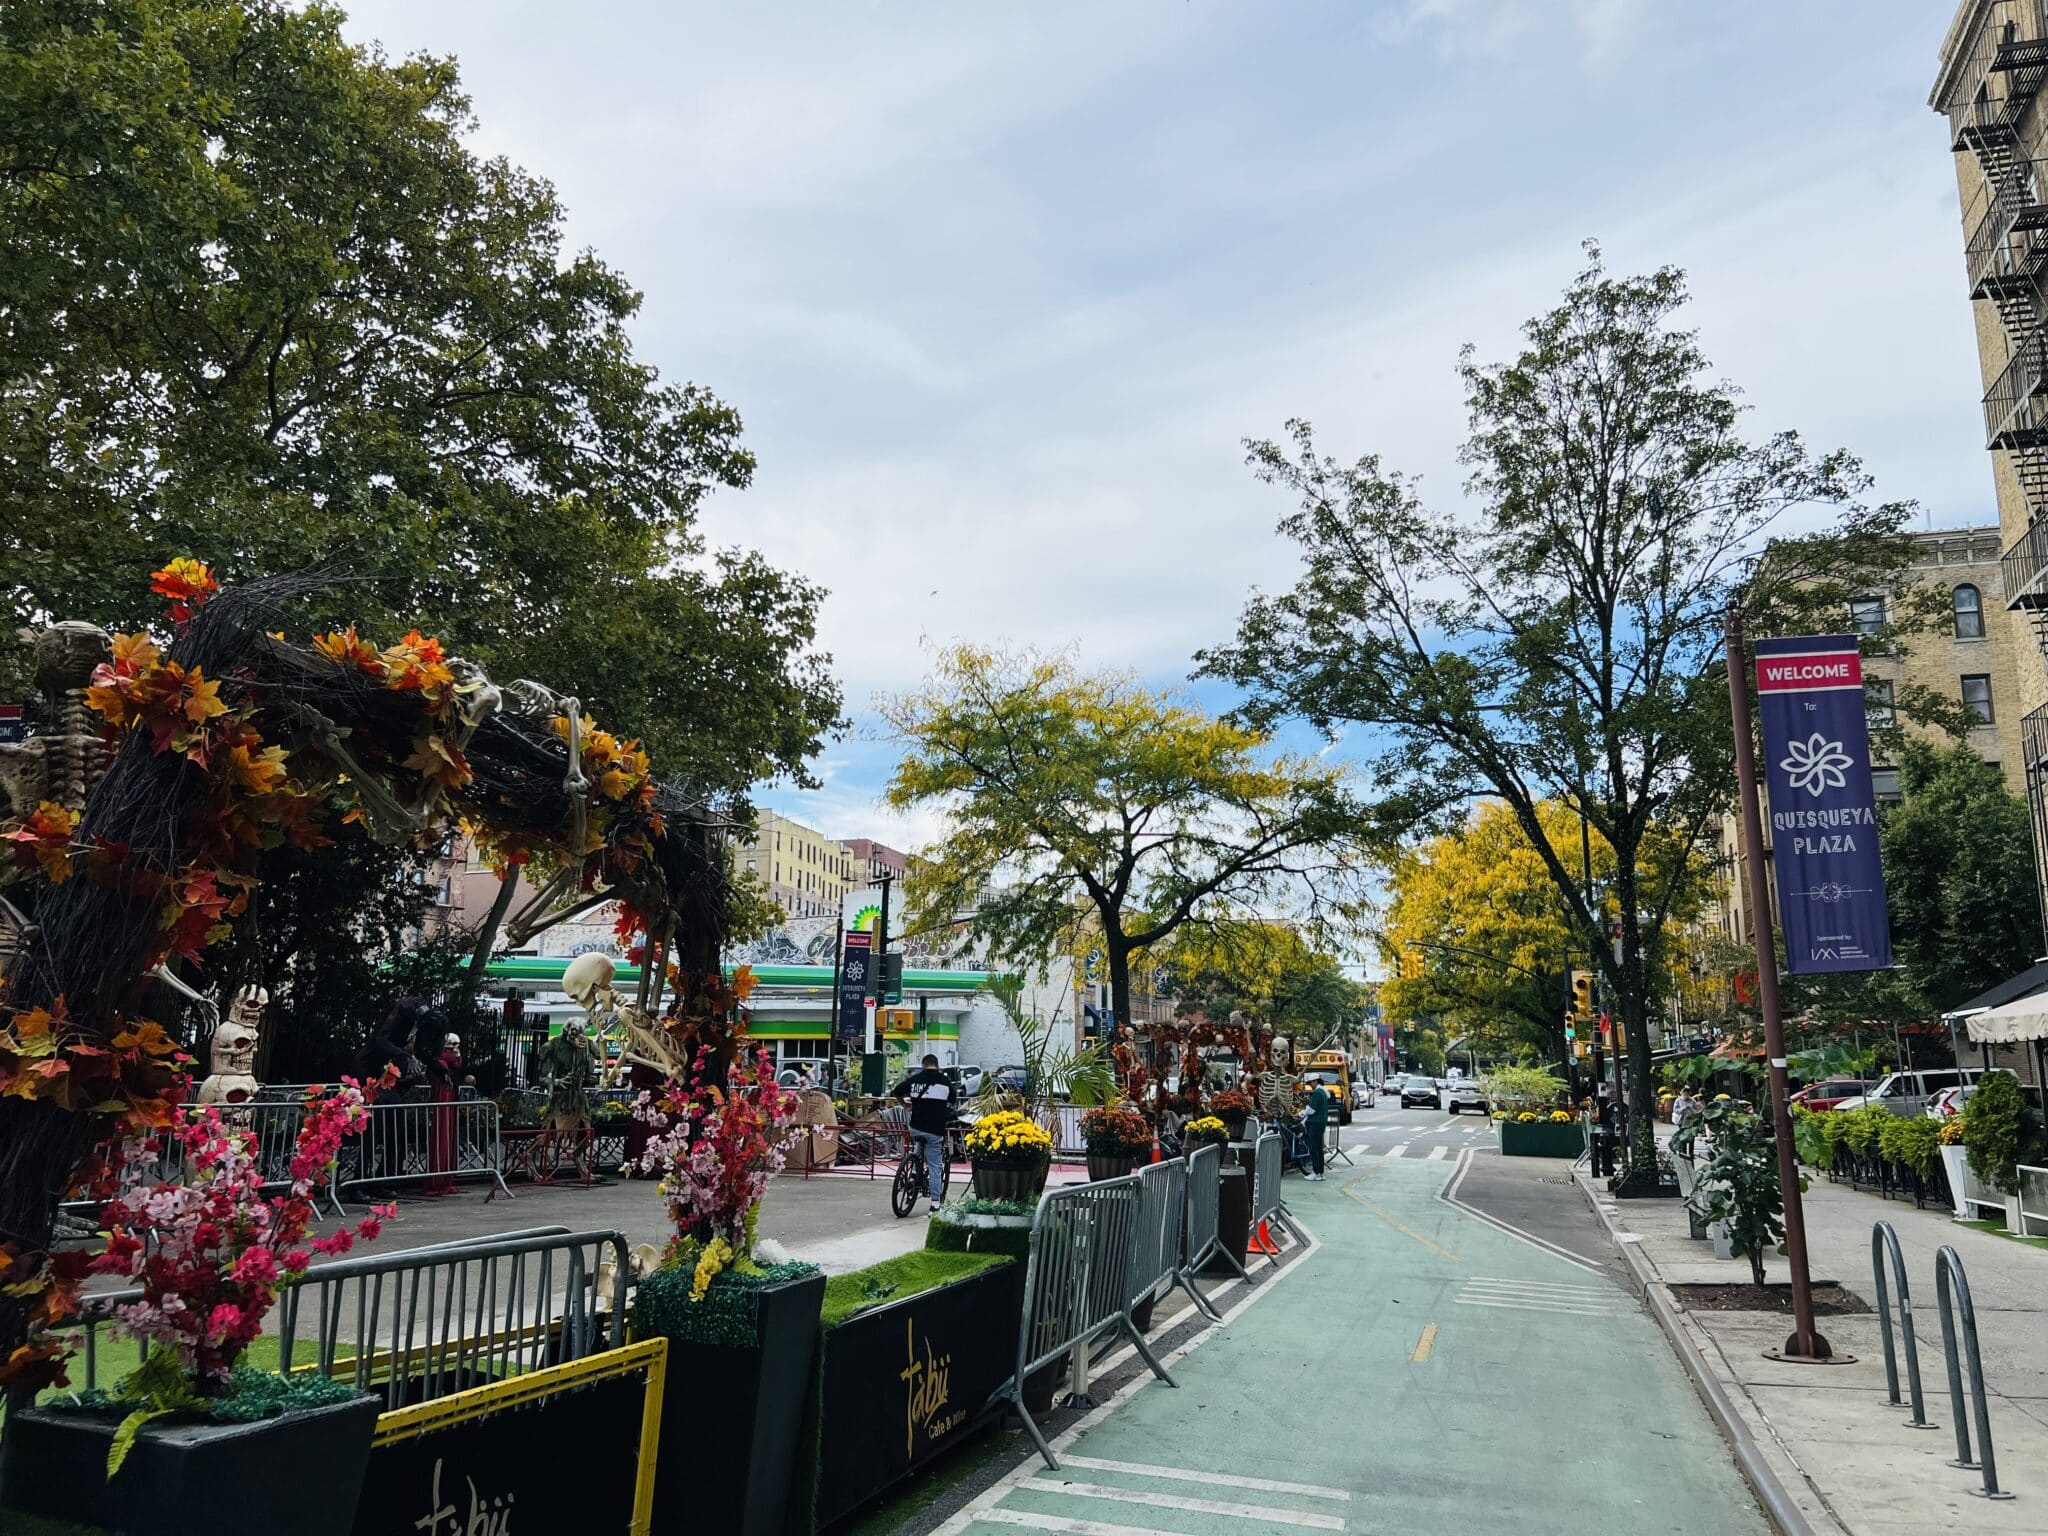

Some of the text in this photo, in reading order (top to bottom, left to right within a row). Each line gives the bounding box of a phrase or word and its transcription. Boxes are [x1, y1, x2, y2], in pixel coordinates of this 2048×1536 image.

[1766, 663, 1850, 682] WELCOME
[1803, 701, 1817, 712] To:
[1774, 806, 1875, 832] QUISQUEYA
[1794, 834, 1857, 856] PLAZA
[847, 937, 870, 945] WELCOME
[928, 1420, 946, 1439] Cafe
[945, 1416, 952, 1431] &
